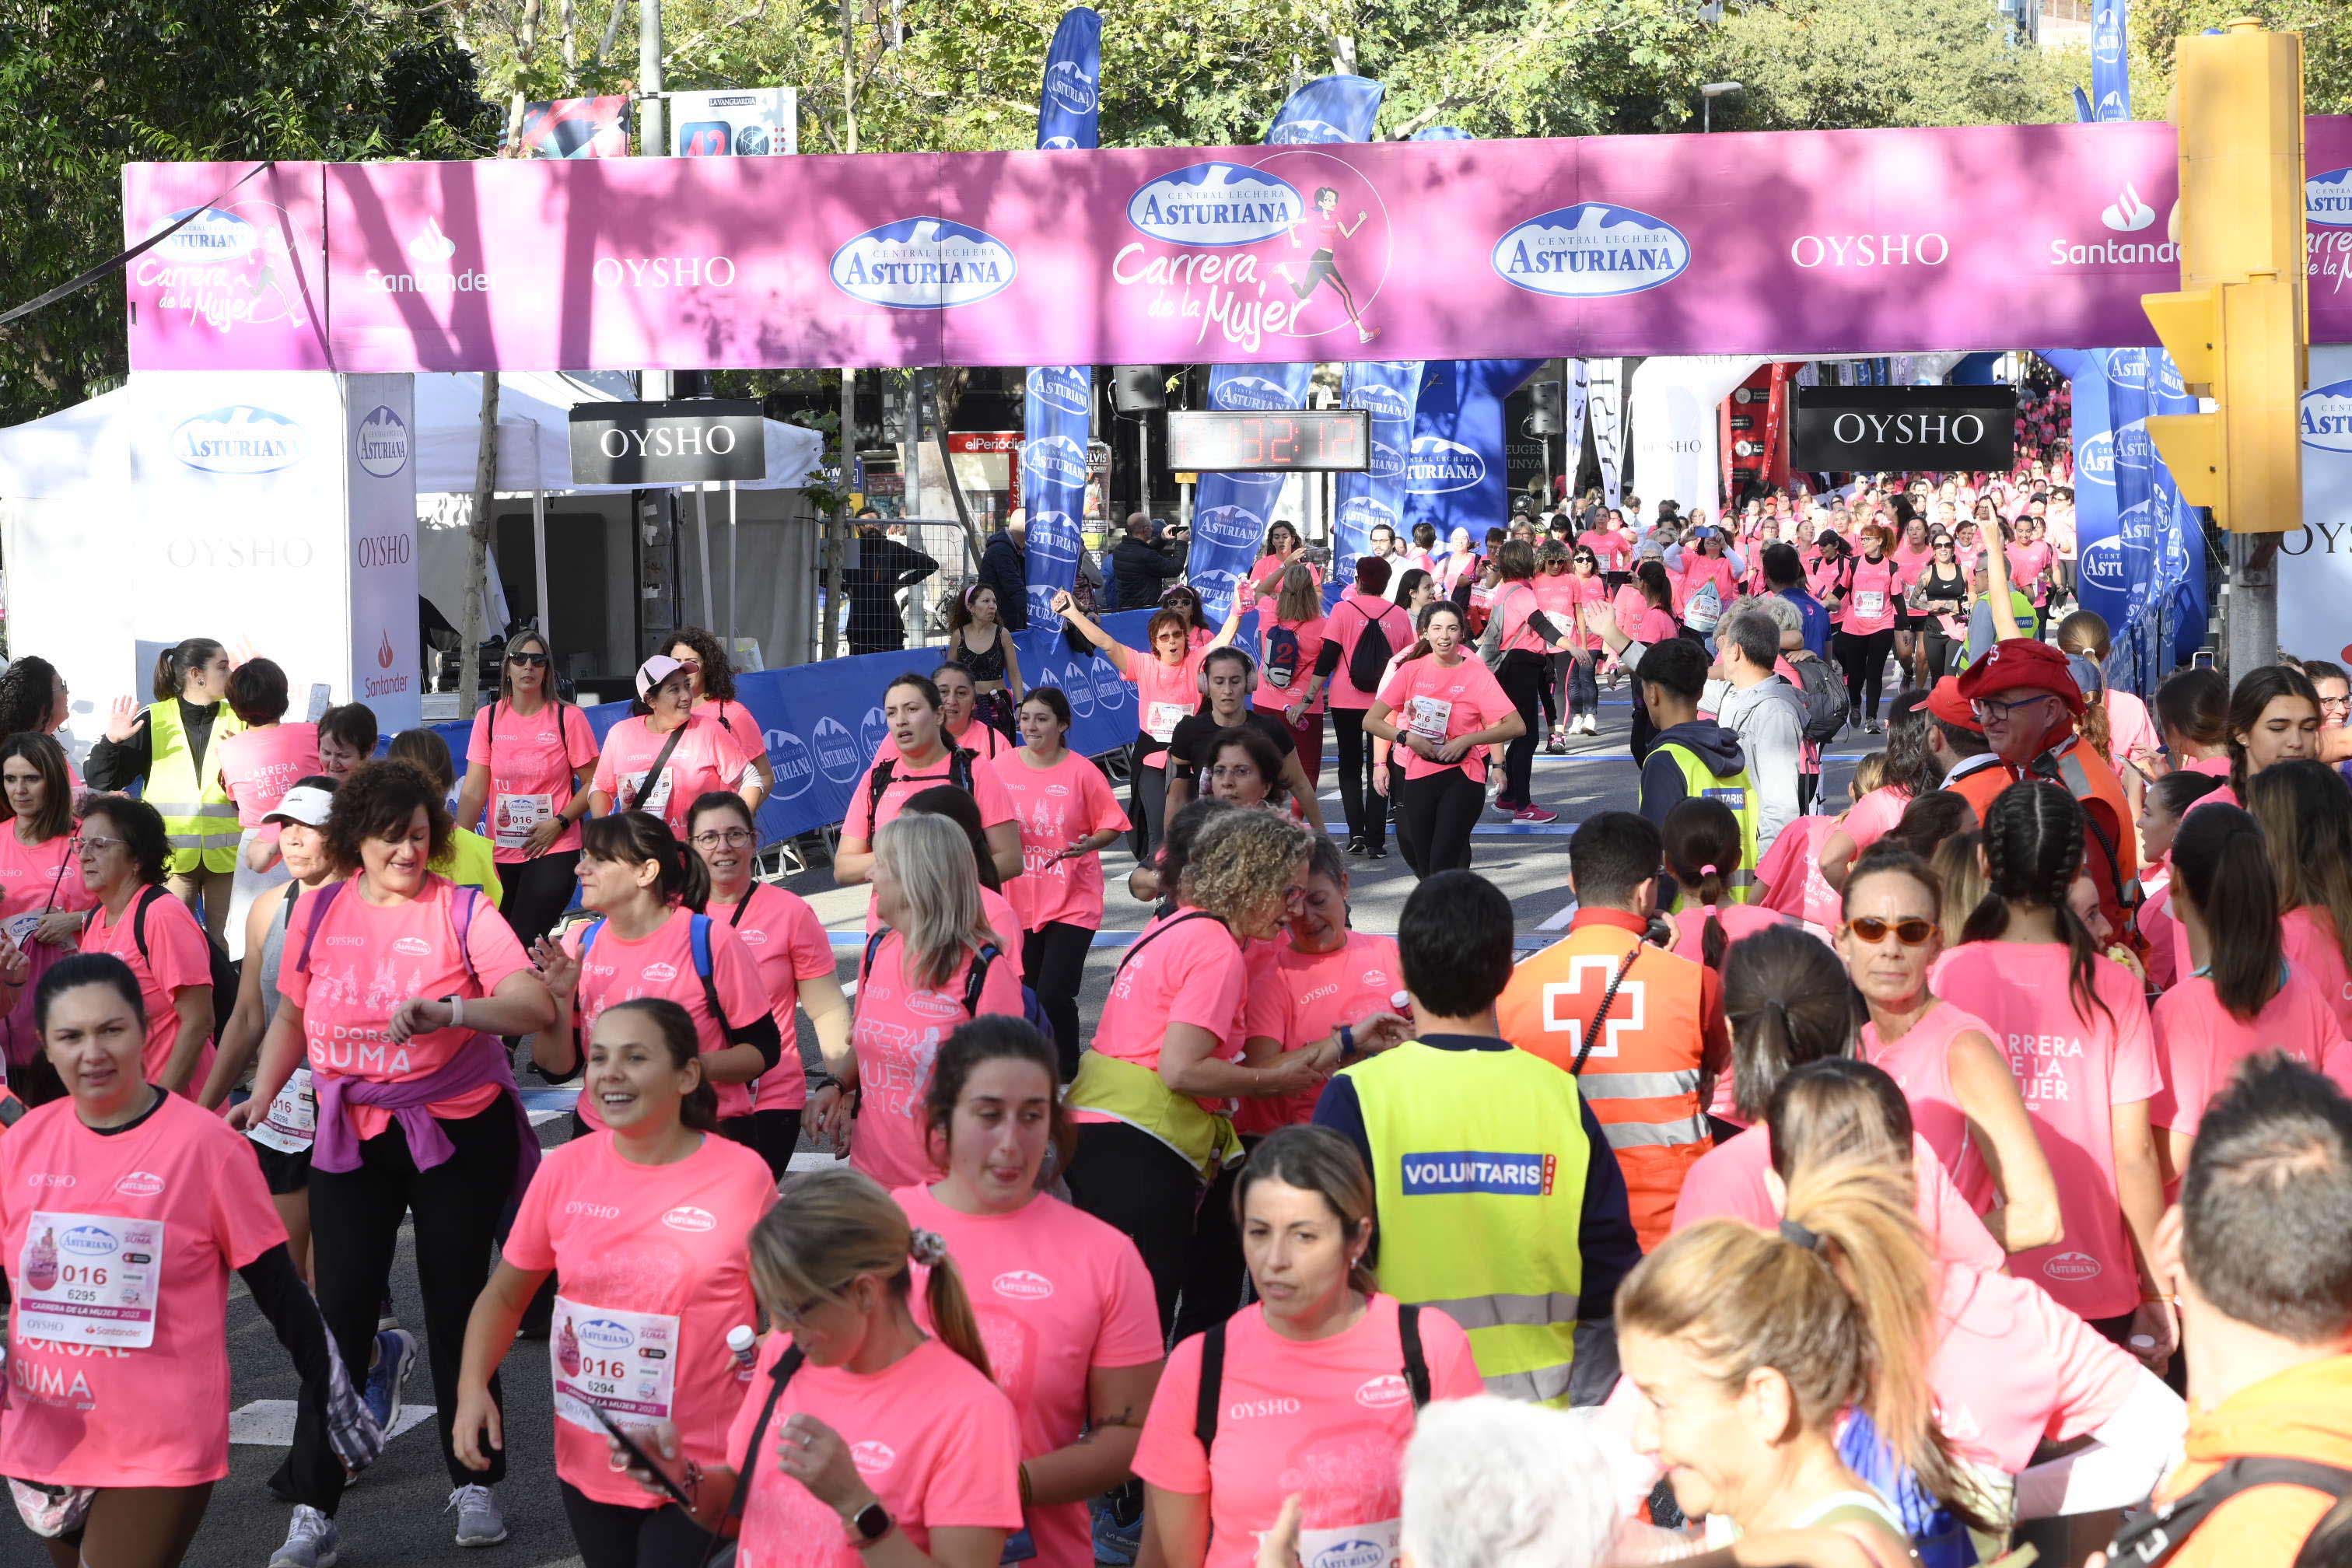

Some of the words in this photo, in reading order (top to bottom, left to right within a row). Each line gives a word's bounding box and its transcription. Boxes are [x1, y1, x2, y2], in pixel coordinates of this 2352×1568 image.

[719, 96, 756, 107] VANGUARDIA
[1167, 190, 1224, 201] CENTRAL
[1230, 188, 1286, 200] LECHERA
[1141, 199, 1290, 226] ASTURIANA
[1538, 235, 1600, 247] CENTRAL
[1606, 233, 1668, 245] LECHERA
[1791, 233, 1949, 268] OYSHO
[873, 248, 934, 259] CENTRAL
[938, 247, 996, 258] LECHERA
[1112, 241, 1258, 285] Carrera
[1507, 238, 1675, 274] ASTURIANA
[136, 257, 228, 288] Carrera
[364, 268, 496, 293] Santander
[593, 255, 736, 289] OYSHO
[844, 253, 1003, 287] ASTURIANA
[190, 290, 263, 334] Mujer
[1148, 289, 1178, 318] de
[1182, 288, 1200, 318] la
[1195, 280, 1314, 353] Mujer
[1032, 373, 1087, 408] ASTURIANA
[1350, 394, 1409, 418] ASTURIANA
[1833, 412, 1985, 445] OYSHO
[181, 432, 299, 457] ASTURIAN
[361, 436, 405, 460] ASTURIANA
[600, 425, 736, 457] OYSHO
[1031, 447, 1085, 480] ASTURIANA
[358, 534, 410, 569] OYSHO
[1276, 643, 1294, 663] 2
[365, 674, 409, 699] Santander
[817, 744, 858, 768] ASTURIANA
[256, 778, 272, 789] DE
[275, 775, 291, 785] LA
[495, 779, 510, 791] TU
[326, 936, 364, 947] OYSHO
[1299, 982, 1339, 1006] OYSHO
[307, 1020, 326, 1036] TU
[334, 1025, 417, 1048] DORSL
[310, 1038, 411, 1074] SUMA
[2035, 1056, 2065, 1078] LA
[272, 1098, 292, 1113] 016
[29, 1172, 76, 1188] OYSHO
[1405, 1162, 1542, 1187] VOLUNTARIS
[565, 1200, 620, 1220] OYSHO
[65, 1237, 113, 1251] ASTURIANA
[62, 1265, 108, 1286] 016
[2049, 1262, 2096, 1276] ASTURIANA
[68, 1289, 96, 1302] 6295
[31, 1302, 65, 1313] CARRERA
[89, 1308, 117, 1318] MUJER
[26, 1319, 65, 1332] OYSHO
[96, 1325, 142, 1338] Santander
[580, 1329, 630, 1345] ASTURIANA
[639, 1330, 667, 1340] SUMA
[16, 1358, 92, 1399] SUMA
[583, 1356, 625, 1379] 016
[588, 1381, 615, 1395] 6294
[1360, 1386, 1412, 1402] ASTURIAN
[608, 1400, 636, 1412] MUJER
[1231, 1398, 1300, 1420] OYSHO
